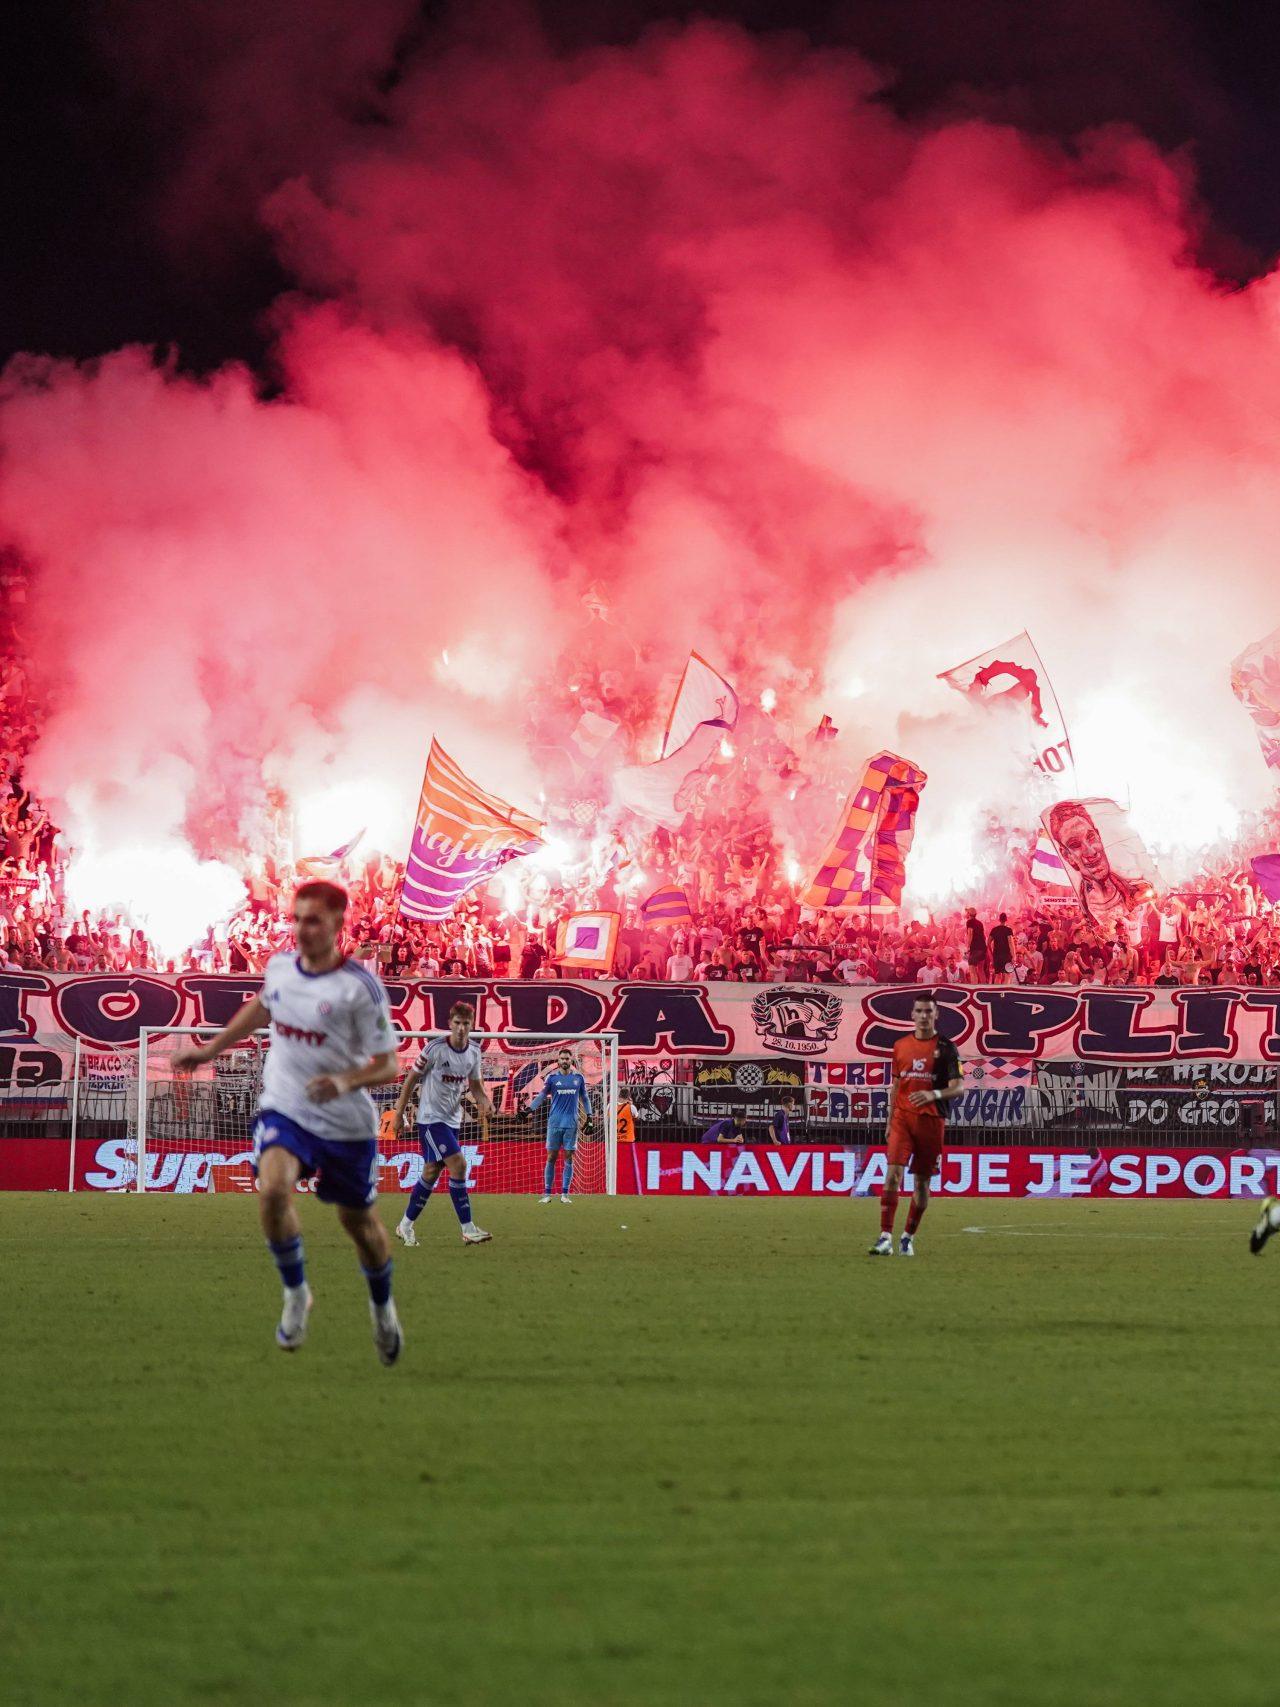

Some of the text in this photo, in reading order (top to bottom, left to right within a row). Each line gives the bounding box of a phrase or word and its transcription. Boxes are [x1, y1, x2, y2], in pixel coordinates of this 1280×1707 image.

[771, 1037, 819, 1051] 28. 10. 1950.
[809, 1061, 891, 1086] TORCI
[809, 1090, 889, 1119] ZAGR
[950, 1086, 1025, 1122] ROGIR
[1128, 1098, 1276, 1126] DO GROA
[647, 1150, 660, 1190] I
[1026, 1154, 1091, 1194] JE
